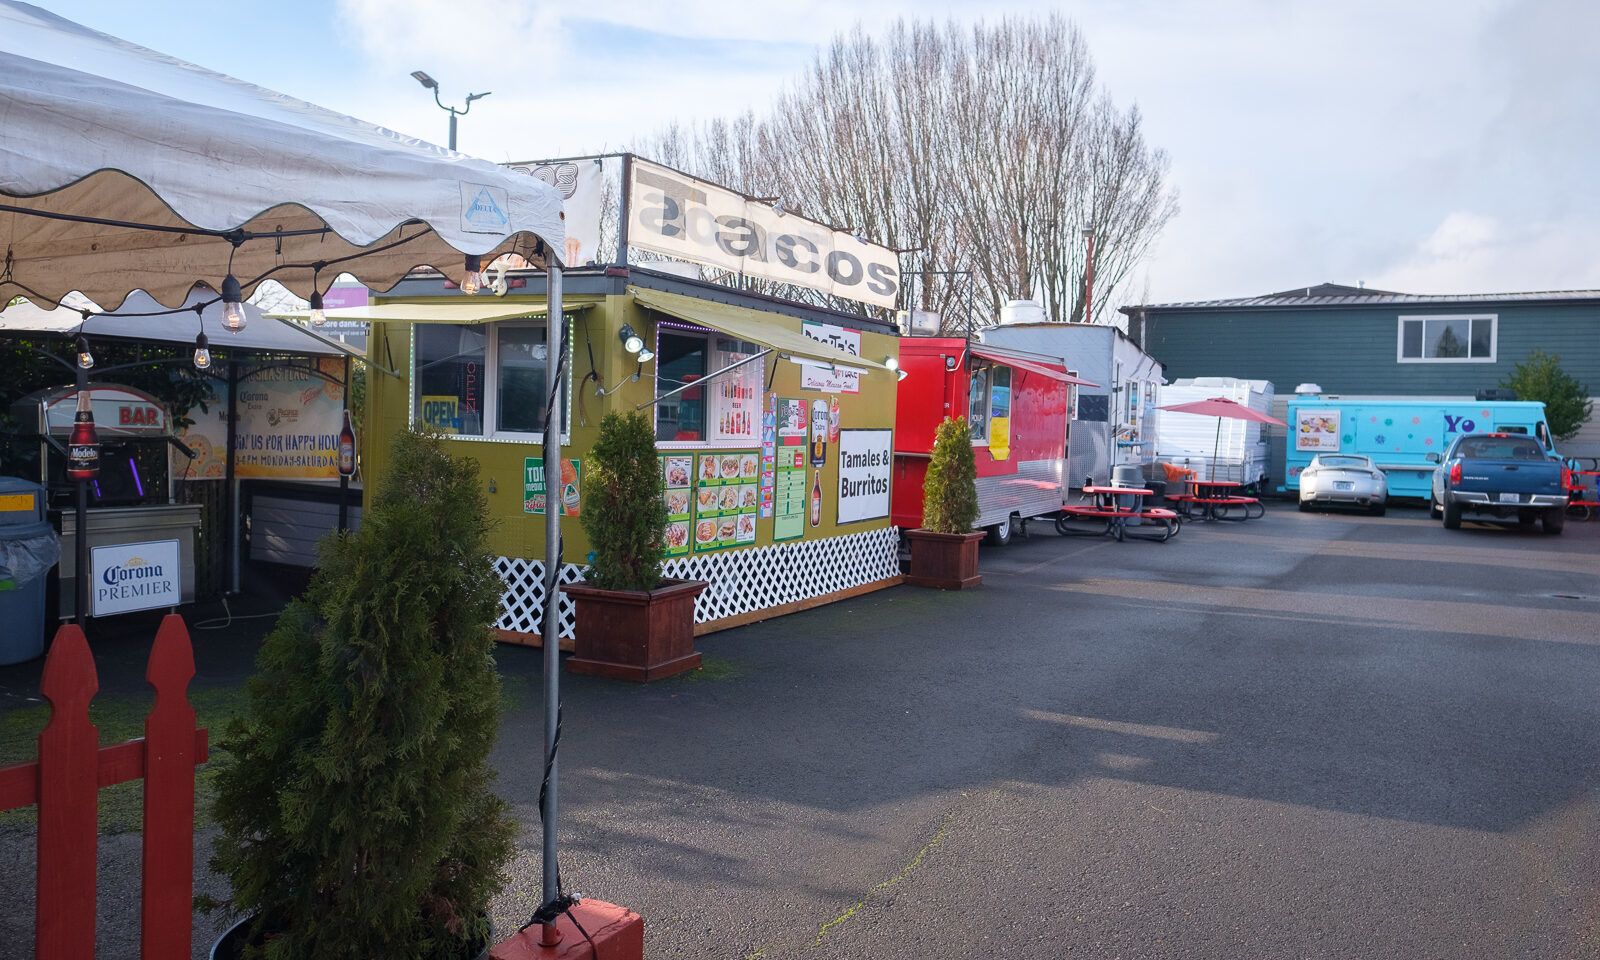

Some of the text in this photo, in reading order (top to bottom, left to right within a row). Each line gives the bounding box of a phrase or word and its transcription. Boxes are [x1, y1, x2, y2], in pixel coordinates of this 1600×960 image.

[636, 166, 897, 297] Tacos
[466, 361, 477, 415] OPEN
[119, 406, 160, 425] BAR
[424, 400, 457, 427] OPEN
[1443, 415, 1475, 433] Yo
[71, 447, 96, 458] Modelo
[251, 435, 263, 450] US
[265, 434, 283, 452] FOR
[285, 434, 316, 451] HAPPY
[318, 434, 339, 451] HOU
[841, 449, 889, 468] Tamales &
[841, 473, 888, 499] Burritos
[103, 564, 163, 587] Corona
[99, 580, 172, 601] PREMIER
